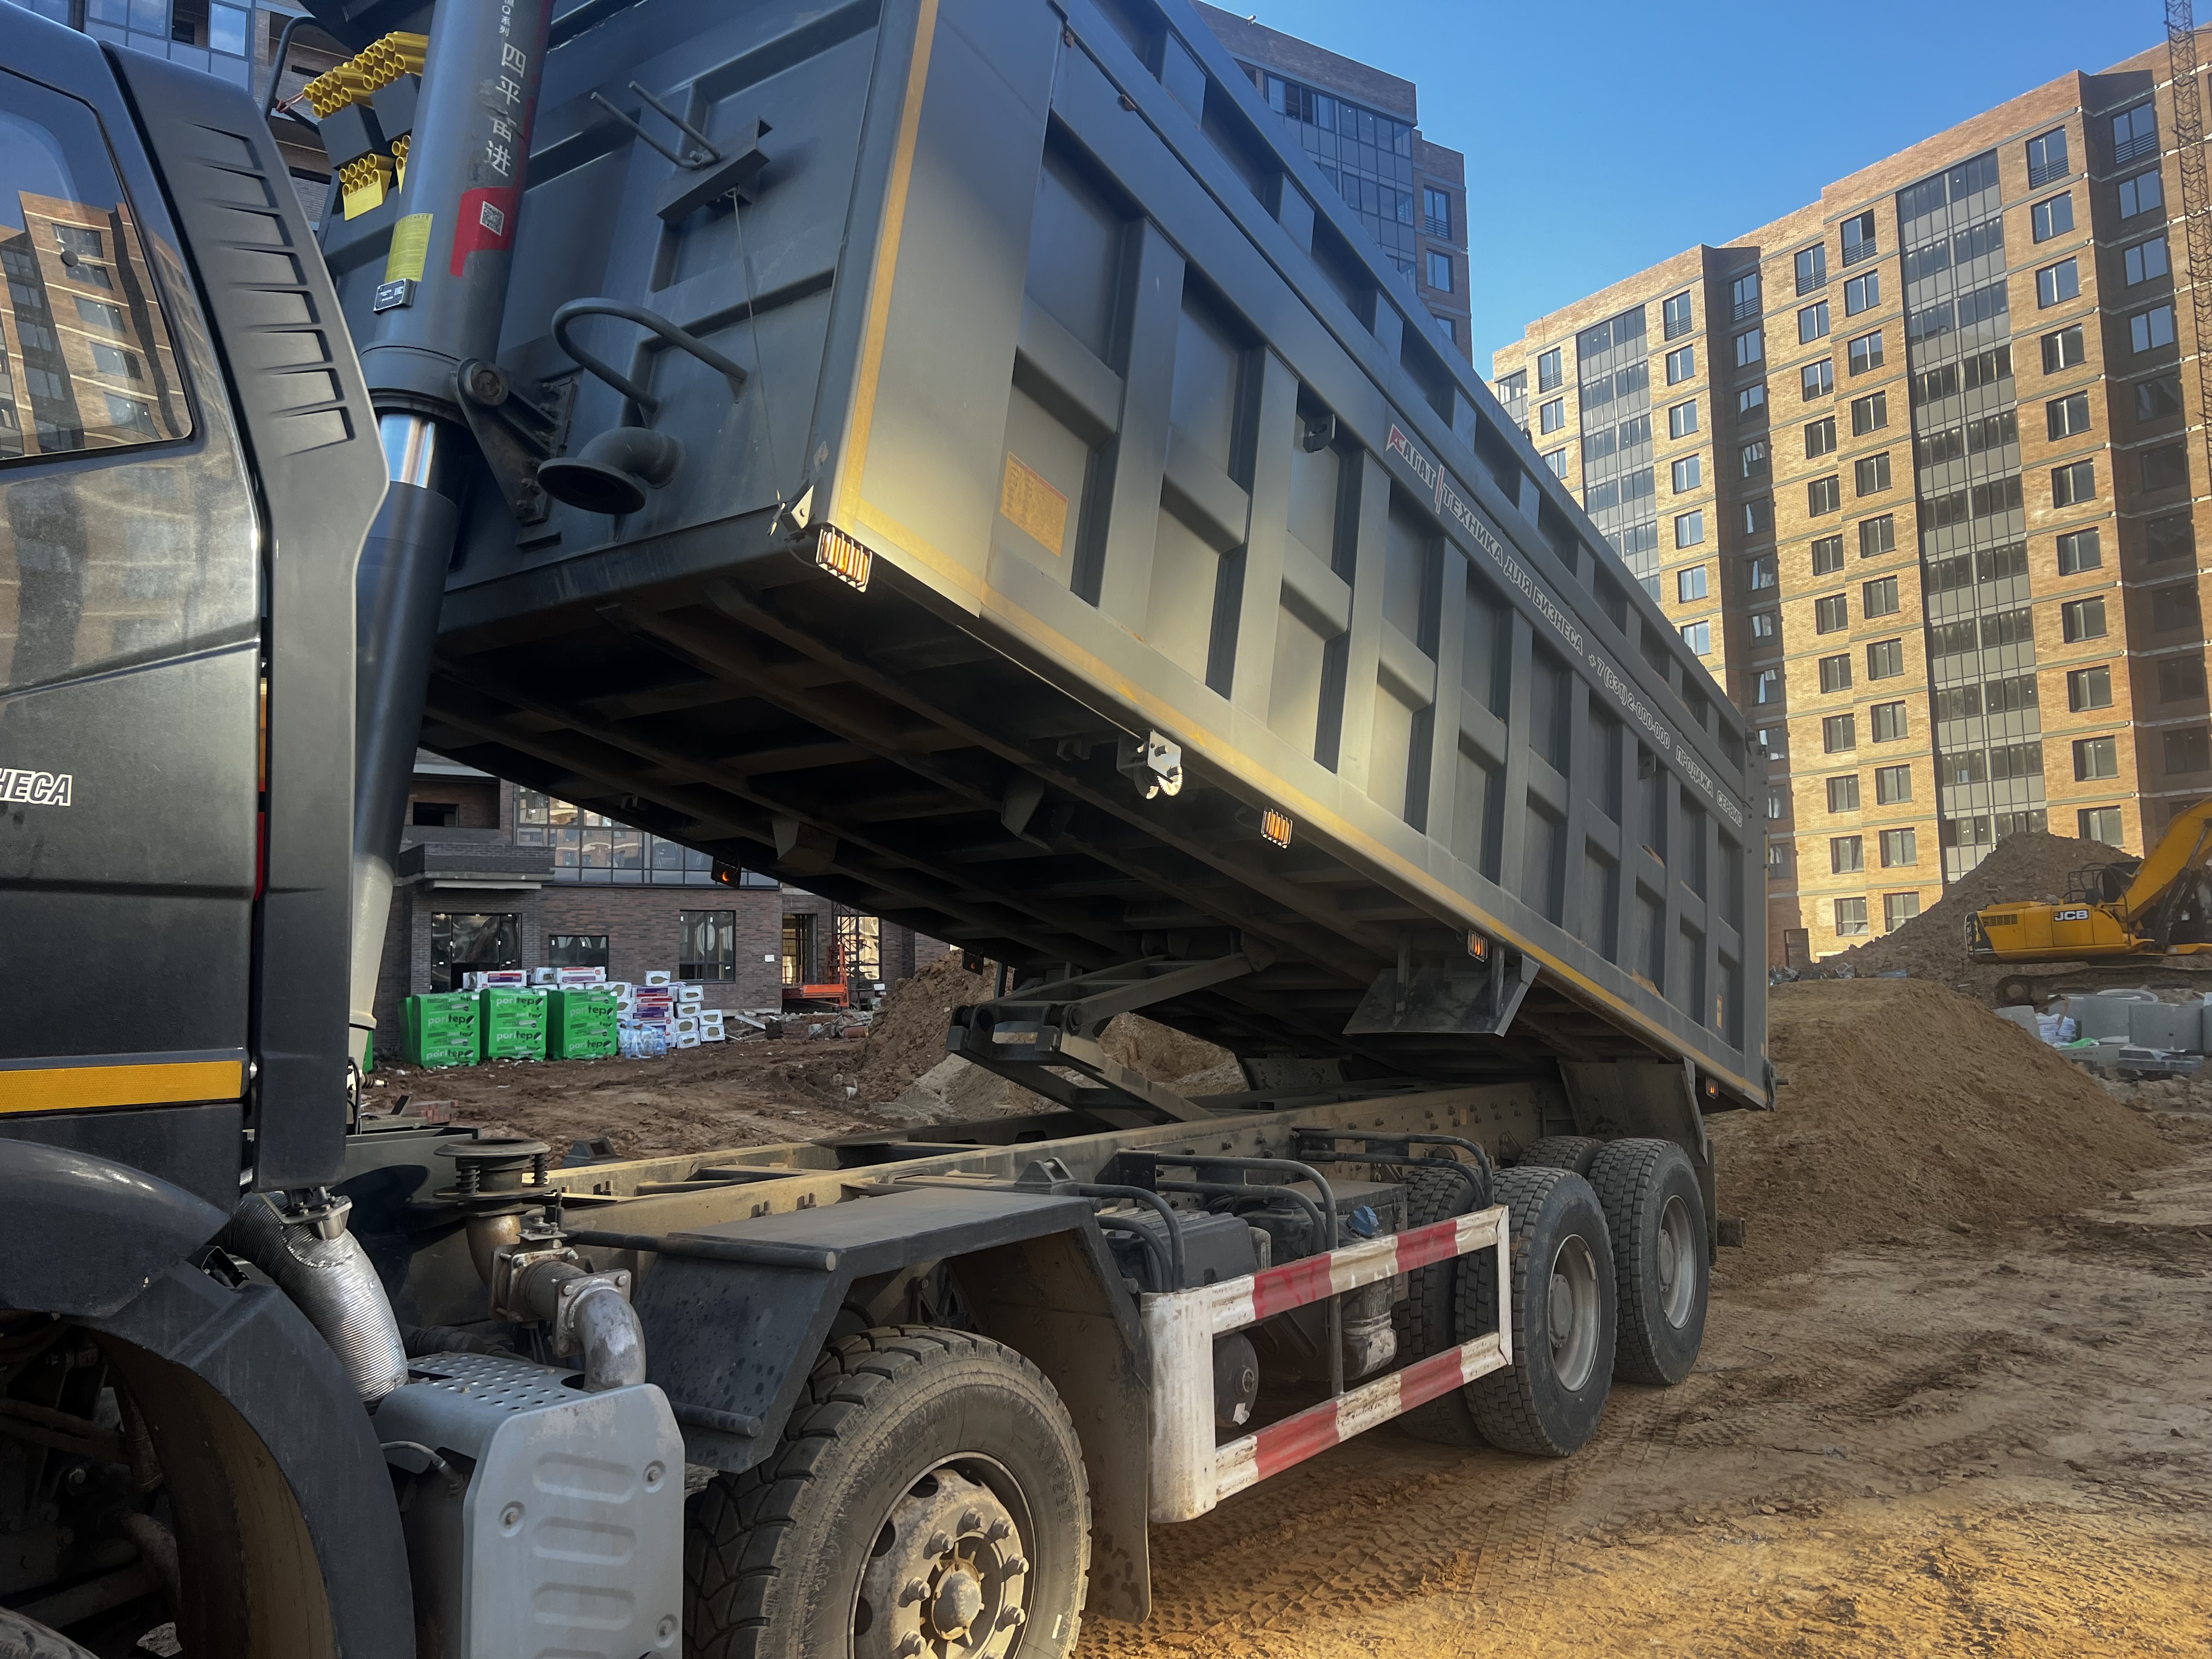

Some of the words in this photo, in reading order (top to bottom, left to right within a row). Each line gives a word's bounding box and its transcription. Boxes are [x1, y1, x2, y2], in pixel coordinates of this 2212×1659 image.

[1403, 439, 1436, 490] АГАТ
[1442, 482, 1503, 568] ТЕХНИКА
[1503, 555, 1533, 599] ДЛЯ
[1533, 585, 1583, 656] БИЗНЕСА
[1588, 653, 1605, 677] +7
[1604, 666, 1628, 706] (831)
[1627, 692, 1671, 749] 2-000-000
[1675, 744, 1713, 798] ПРОДАЖА
[1717, 790, 1743, 827] СЕРВИС
[2055, 910, 2089, 921] JCB
